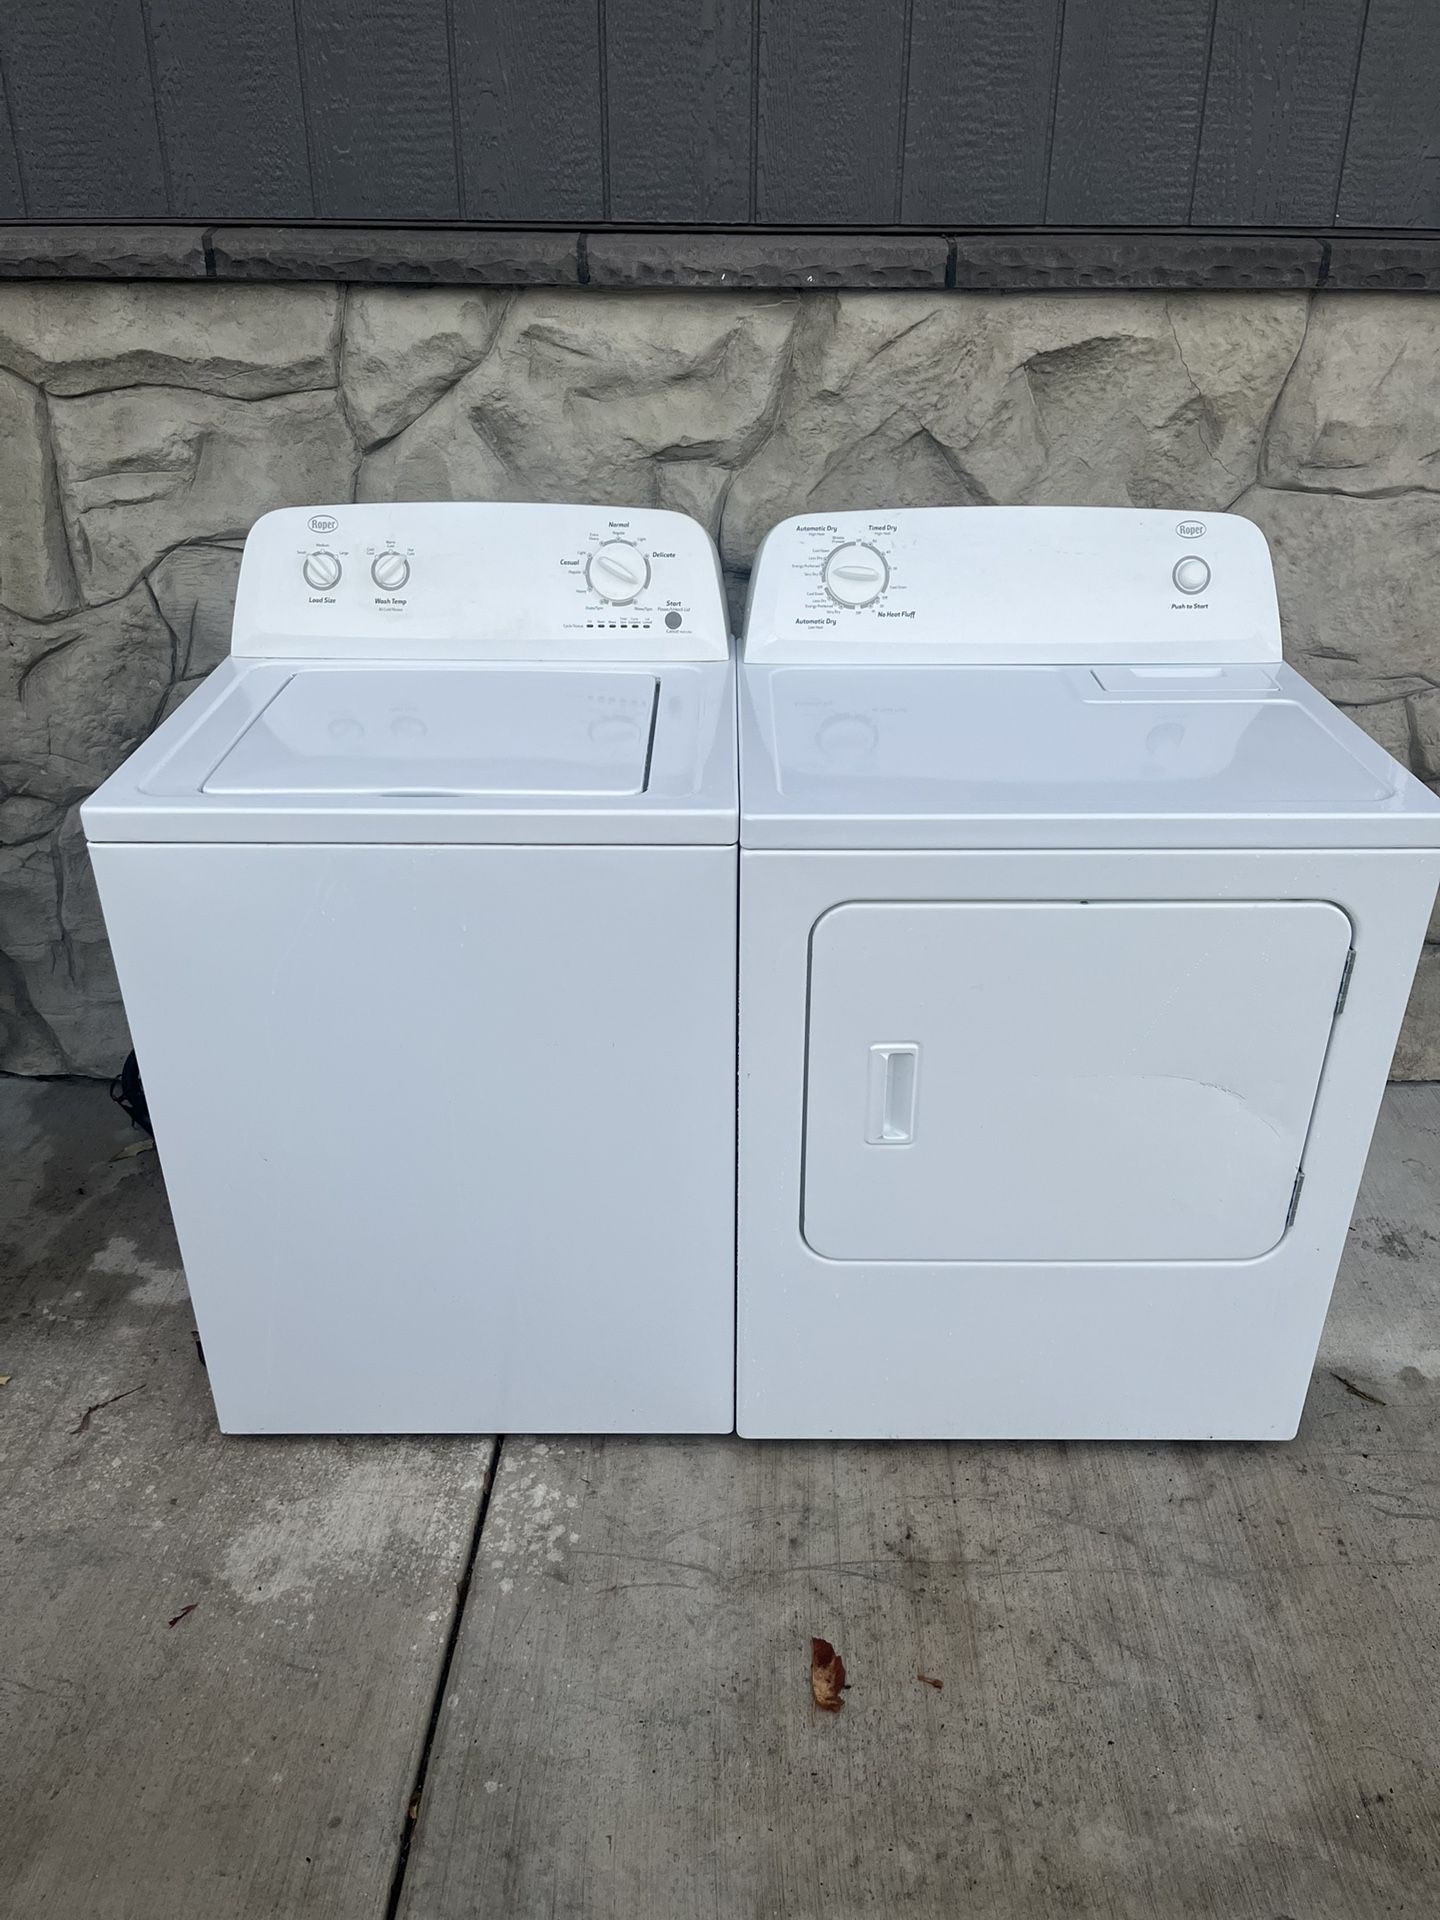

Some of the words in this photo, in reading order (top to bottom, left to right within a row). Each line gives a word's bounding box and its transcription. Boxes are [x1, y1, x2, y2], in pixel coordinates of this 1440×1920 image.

[312, 520, 335, 530] Roper
[827, 525, 838, 533] Dry
[1180, 525, 1203, 535] Roper
[392, 598, 407, 606] Temp
[901, 611, 916, 619] Fluff
[826, 618, 837, 626] Dry
